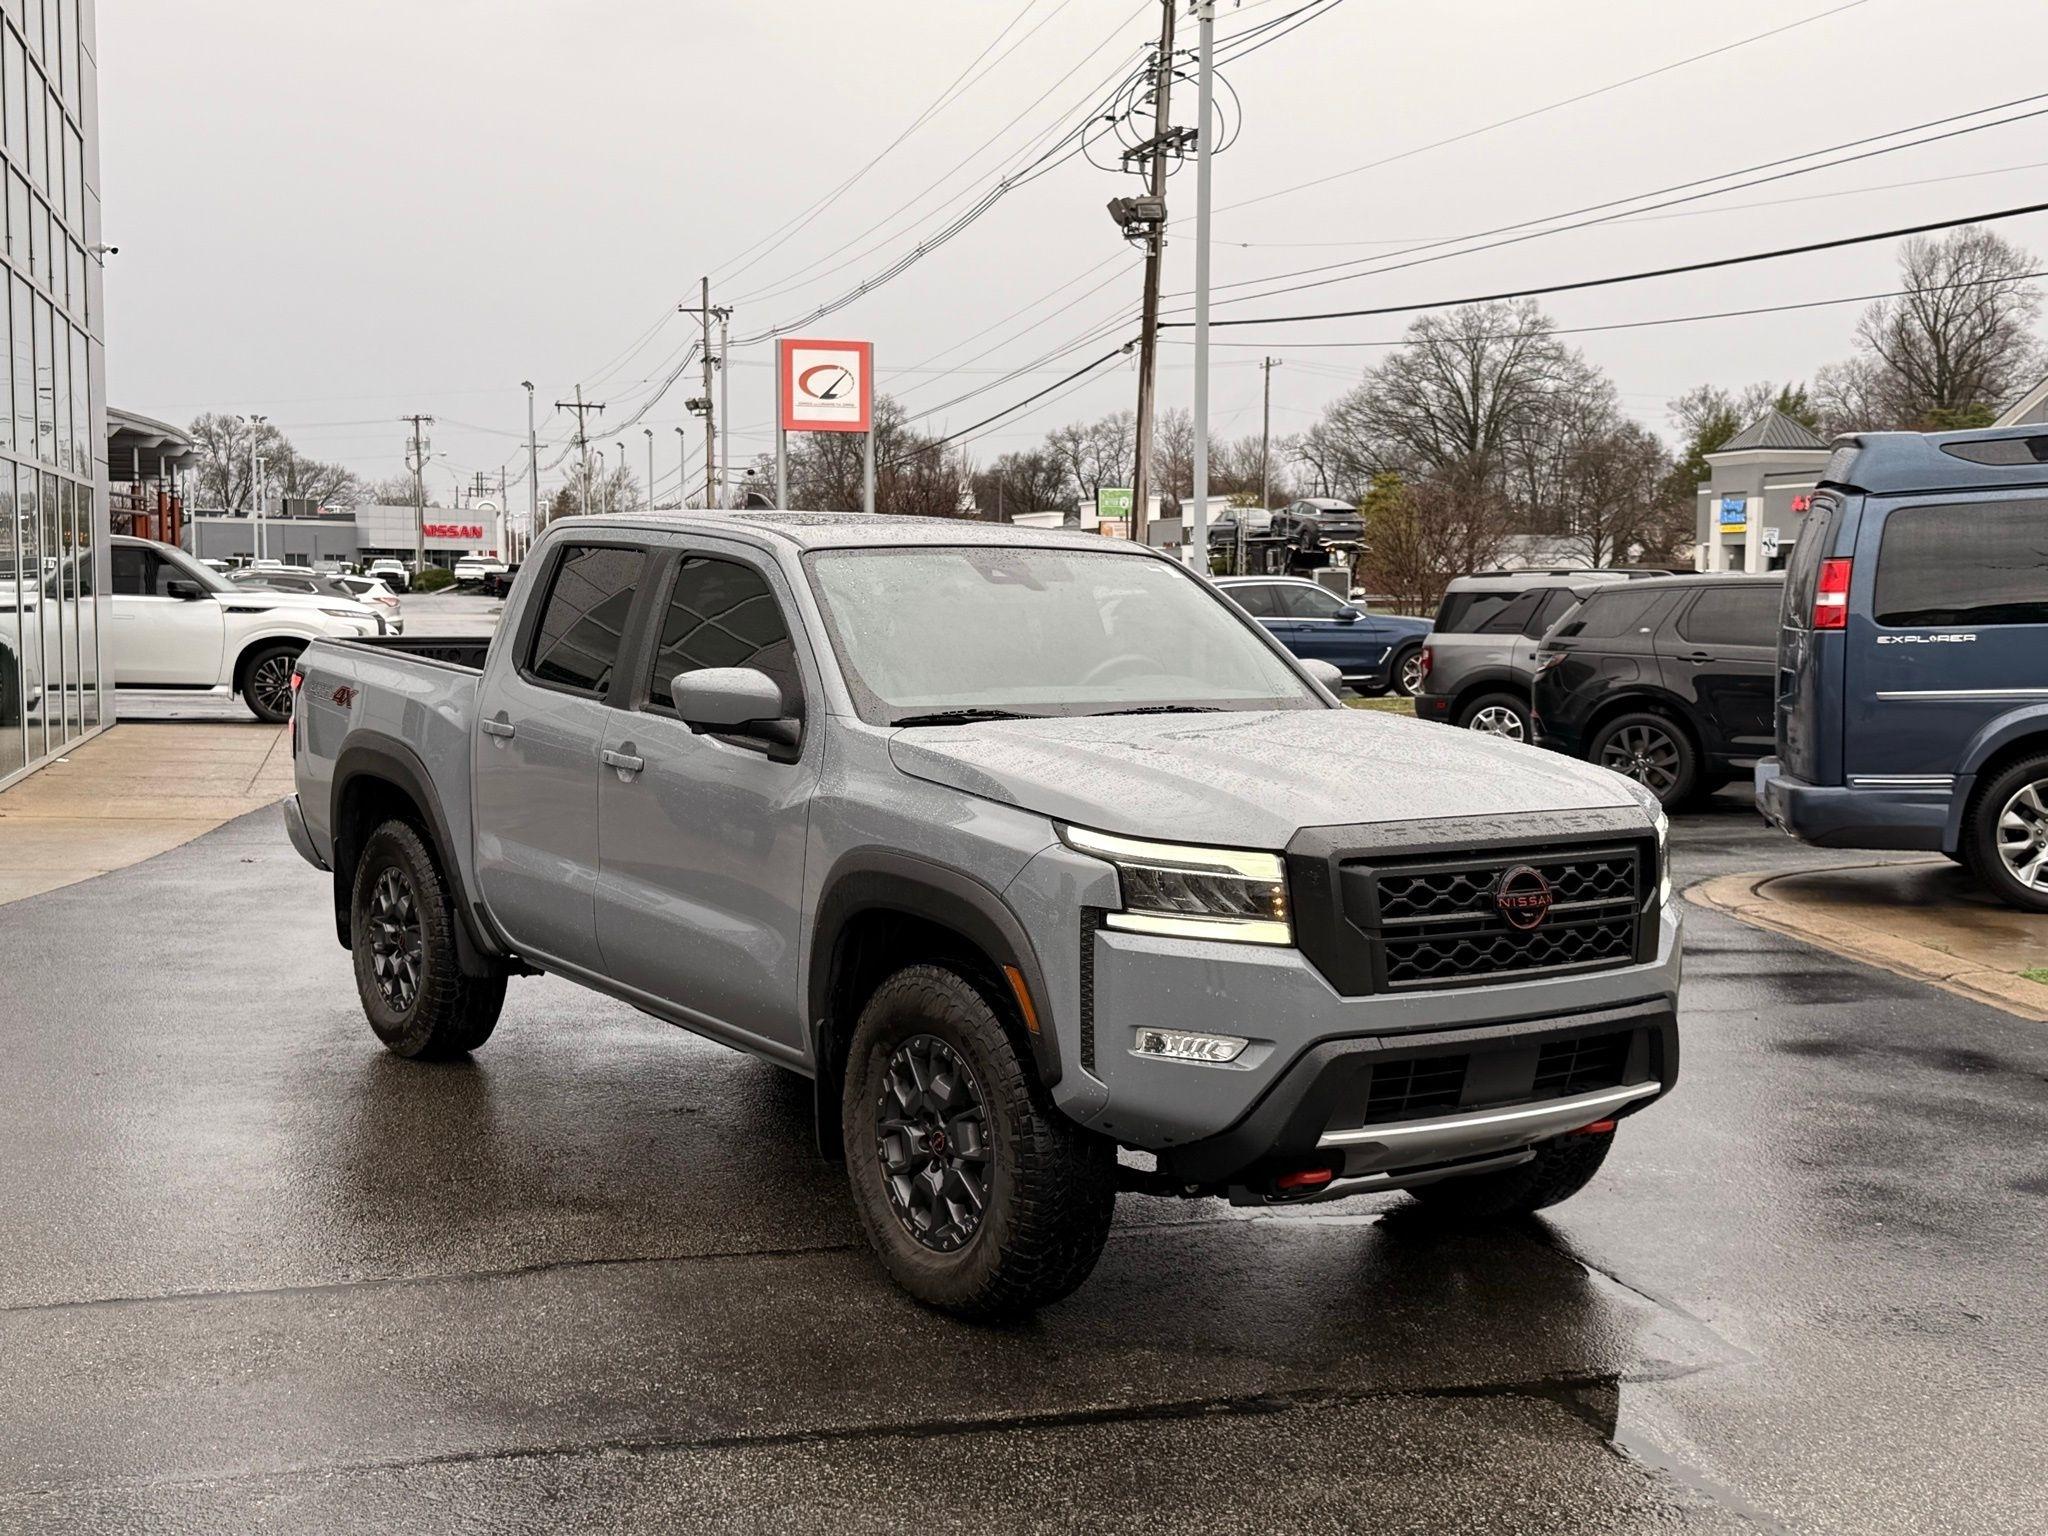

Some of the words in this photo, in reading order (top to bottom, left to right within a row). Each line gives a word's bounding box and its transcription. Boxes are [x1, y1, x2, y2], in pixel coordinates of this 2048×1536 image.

[422, 524, 483, 539] NISSAN
[1877, 634, 1976, 644] EXPLORER
[1499, 895, 1552, 907] NISSAN
